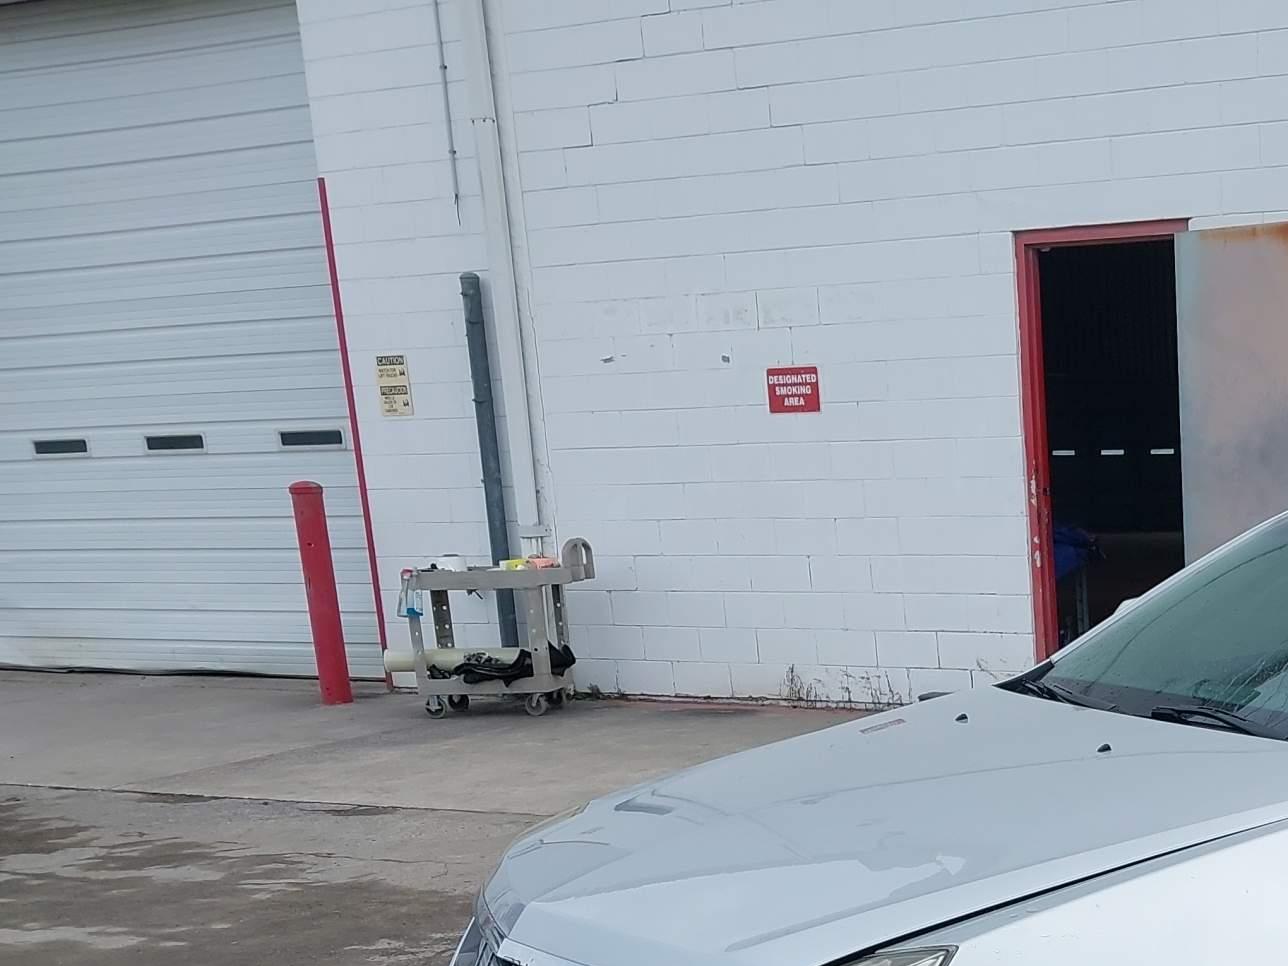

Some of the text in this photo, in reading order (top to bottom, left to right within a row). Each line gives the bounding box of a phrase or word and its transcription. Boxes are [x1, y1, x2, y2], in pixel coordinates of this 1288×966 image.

[377, 356, 404, 365] CAUTION
[768, 374, 817, 384] DESIGNATED
[775, 385, 812, 395] SMOKING
[784, 397, 805, 406] AREA
